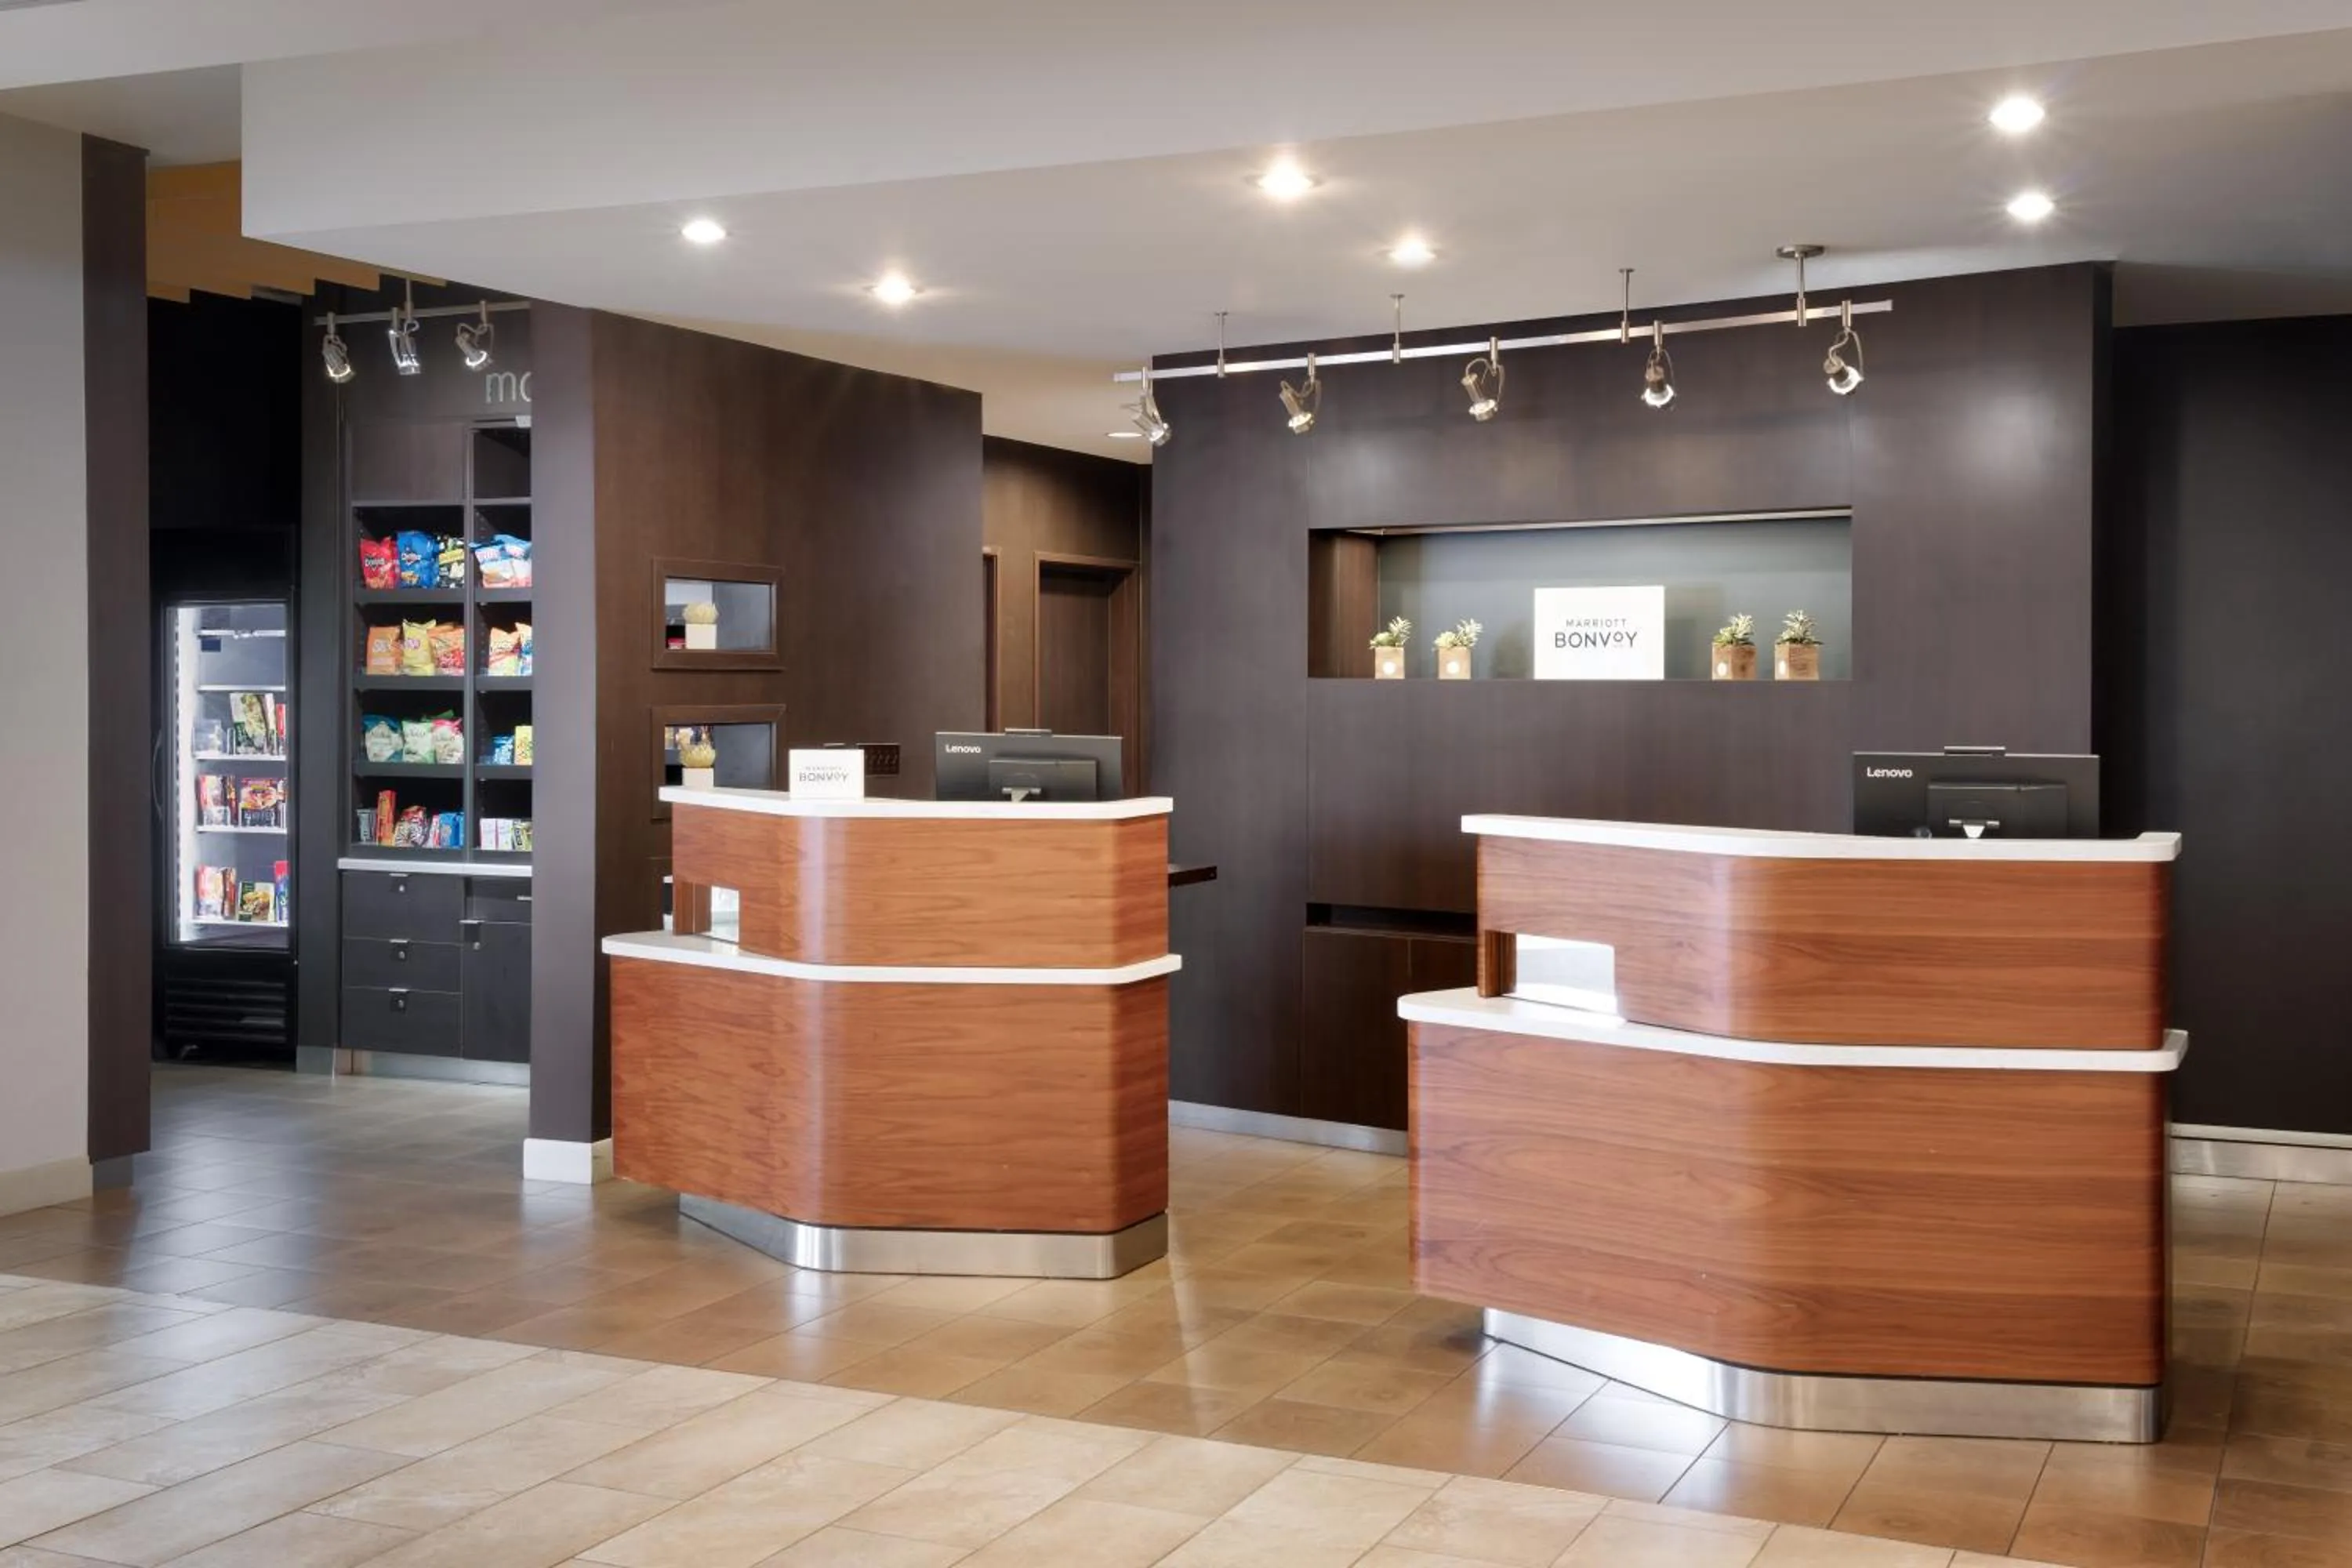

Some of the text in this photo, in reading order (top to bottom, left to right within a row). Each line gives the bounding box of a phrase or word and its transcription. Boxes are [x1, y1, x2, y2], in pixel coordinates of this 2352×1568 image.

[1566, 619, 1627, 628] MARRIOTT
[1555, 631, 1638, 648] BONVOY
[945, 744, 982, 753] Lenovo
[1867, 767, 1913, 778] Lenovo
